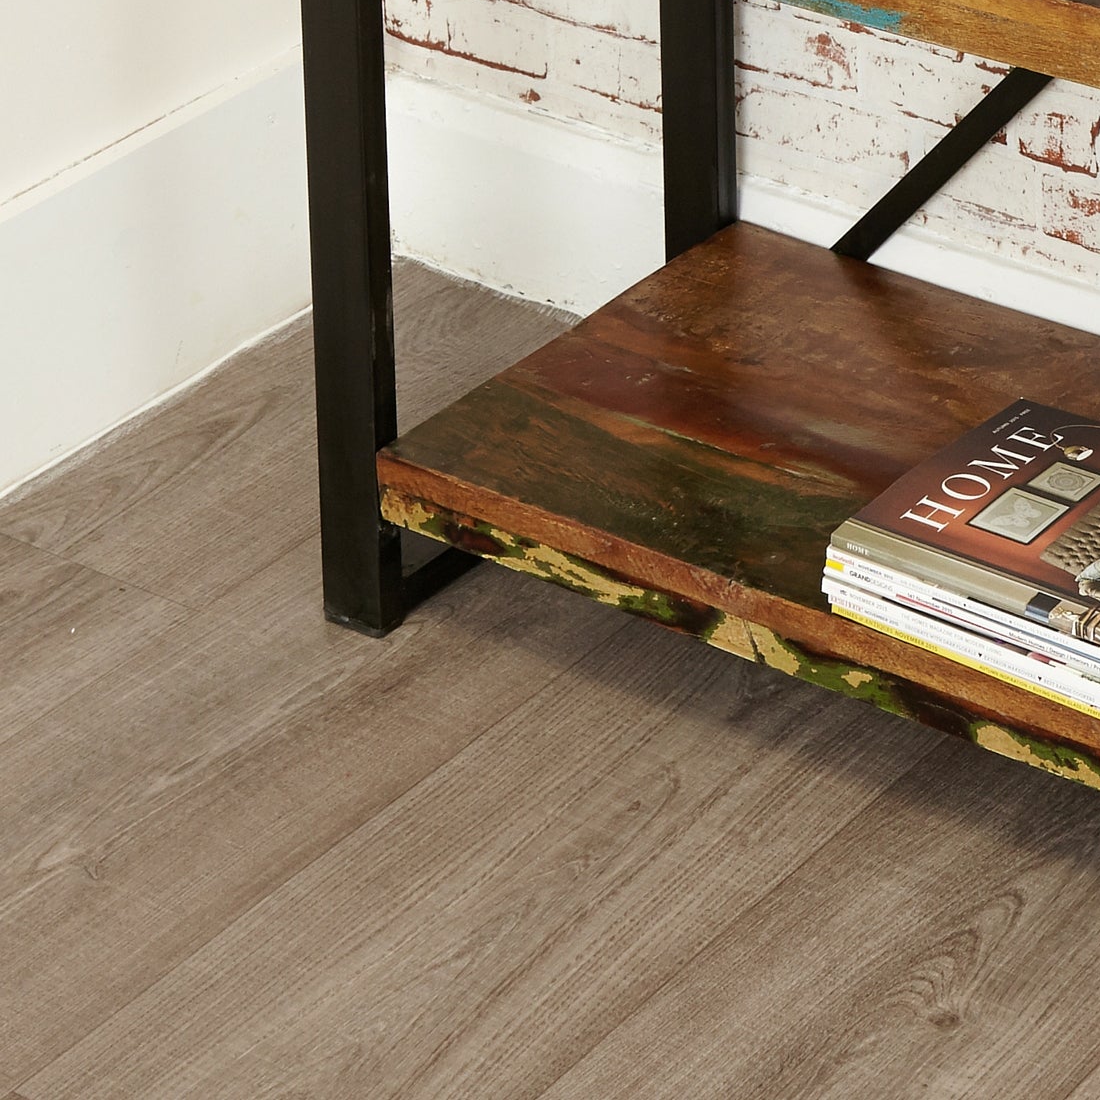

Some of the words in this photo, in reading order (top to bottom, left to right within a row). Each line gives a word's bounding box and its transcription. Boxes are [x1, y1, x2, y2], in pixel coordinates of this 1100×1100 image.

[899, 426, 1064, 533] HOME
[846, 542, 870, 556] HOME
[895, 630, 924, 646] NOVEMBER
